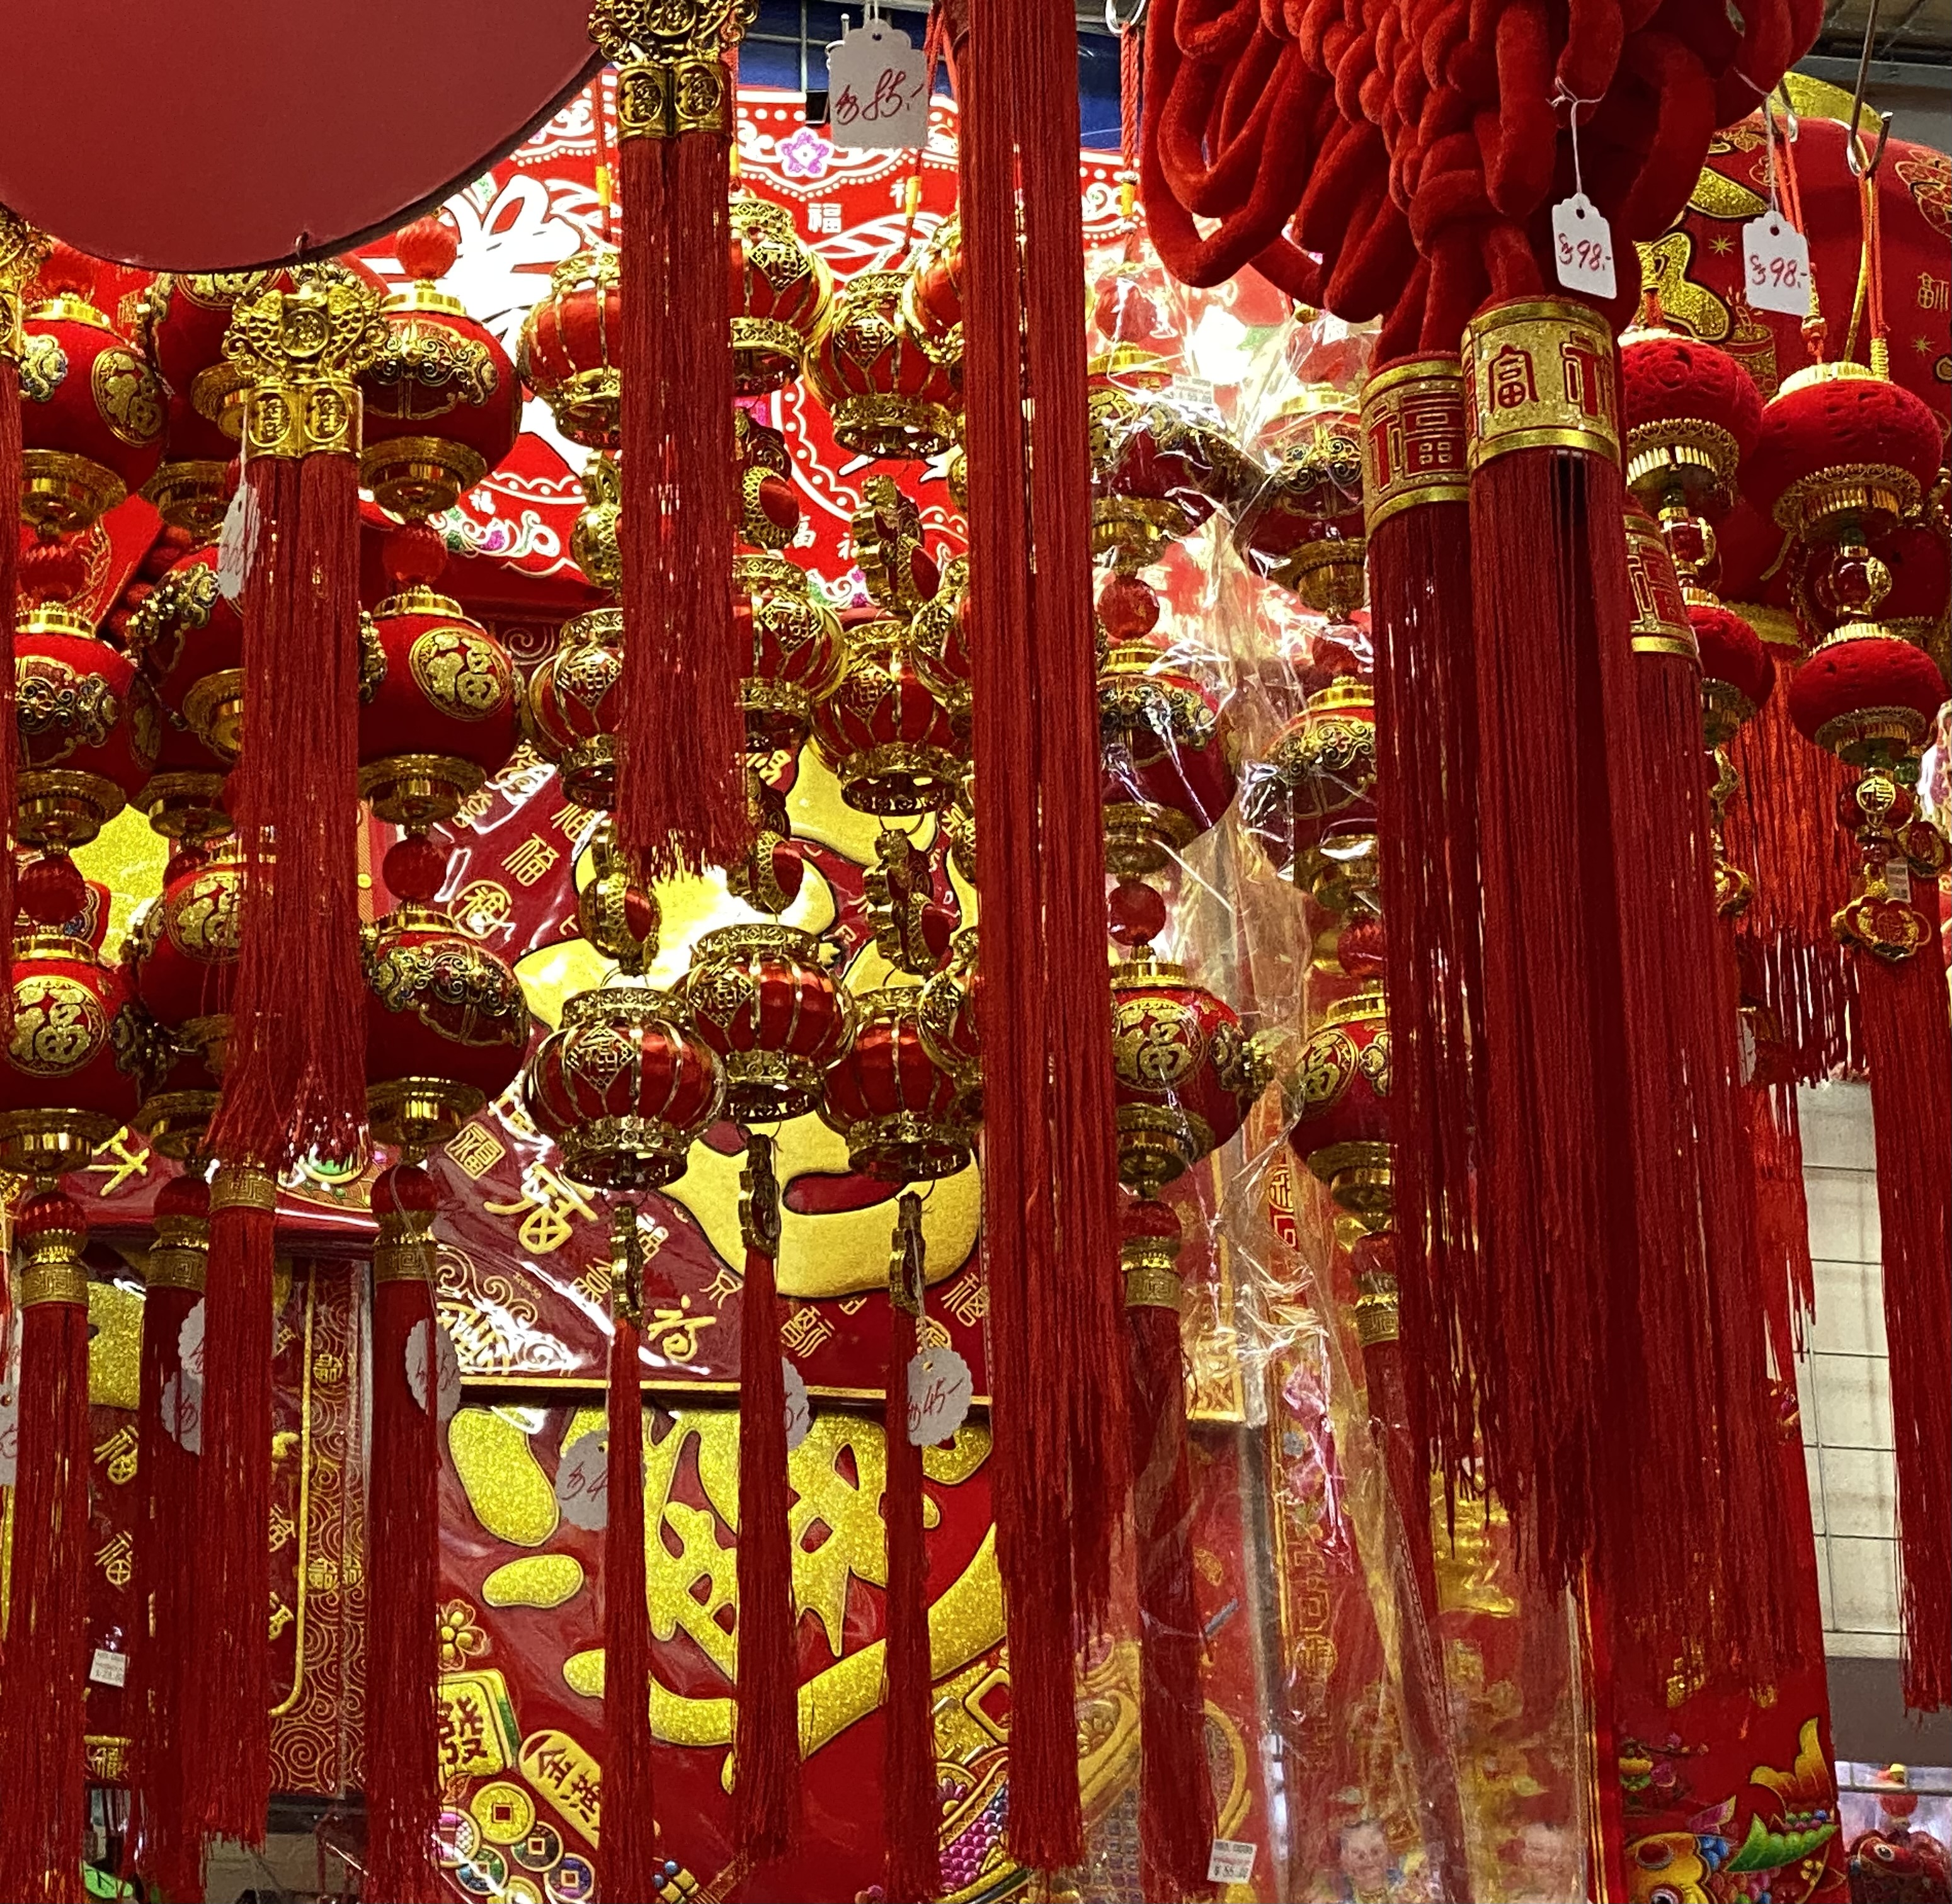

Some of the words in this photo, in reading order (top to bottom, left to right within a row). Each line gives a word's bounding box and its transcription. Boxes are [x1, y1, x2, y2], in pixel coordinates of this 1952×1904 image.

[808, 202, 842, 233] 福
[1488, 343, 1540, 414] 富
[426, 633, 501, 710] 福
[501, 832, 561, 887] 福
[9, 986, 92, 1064] 福
